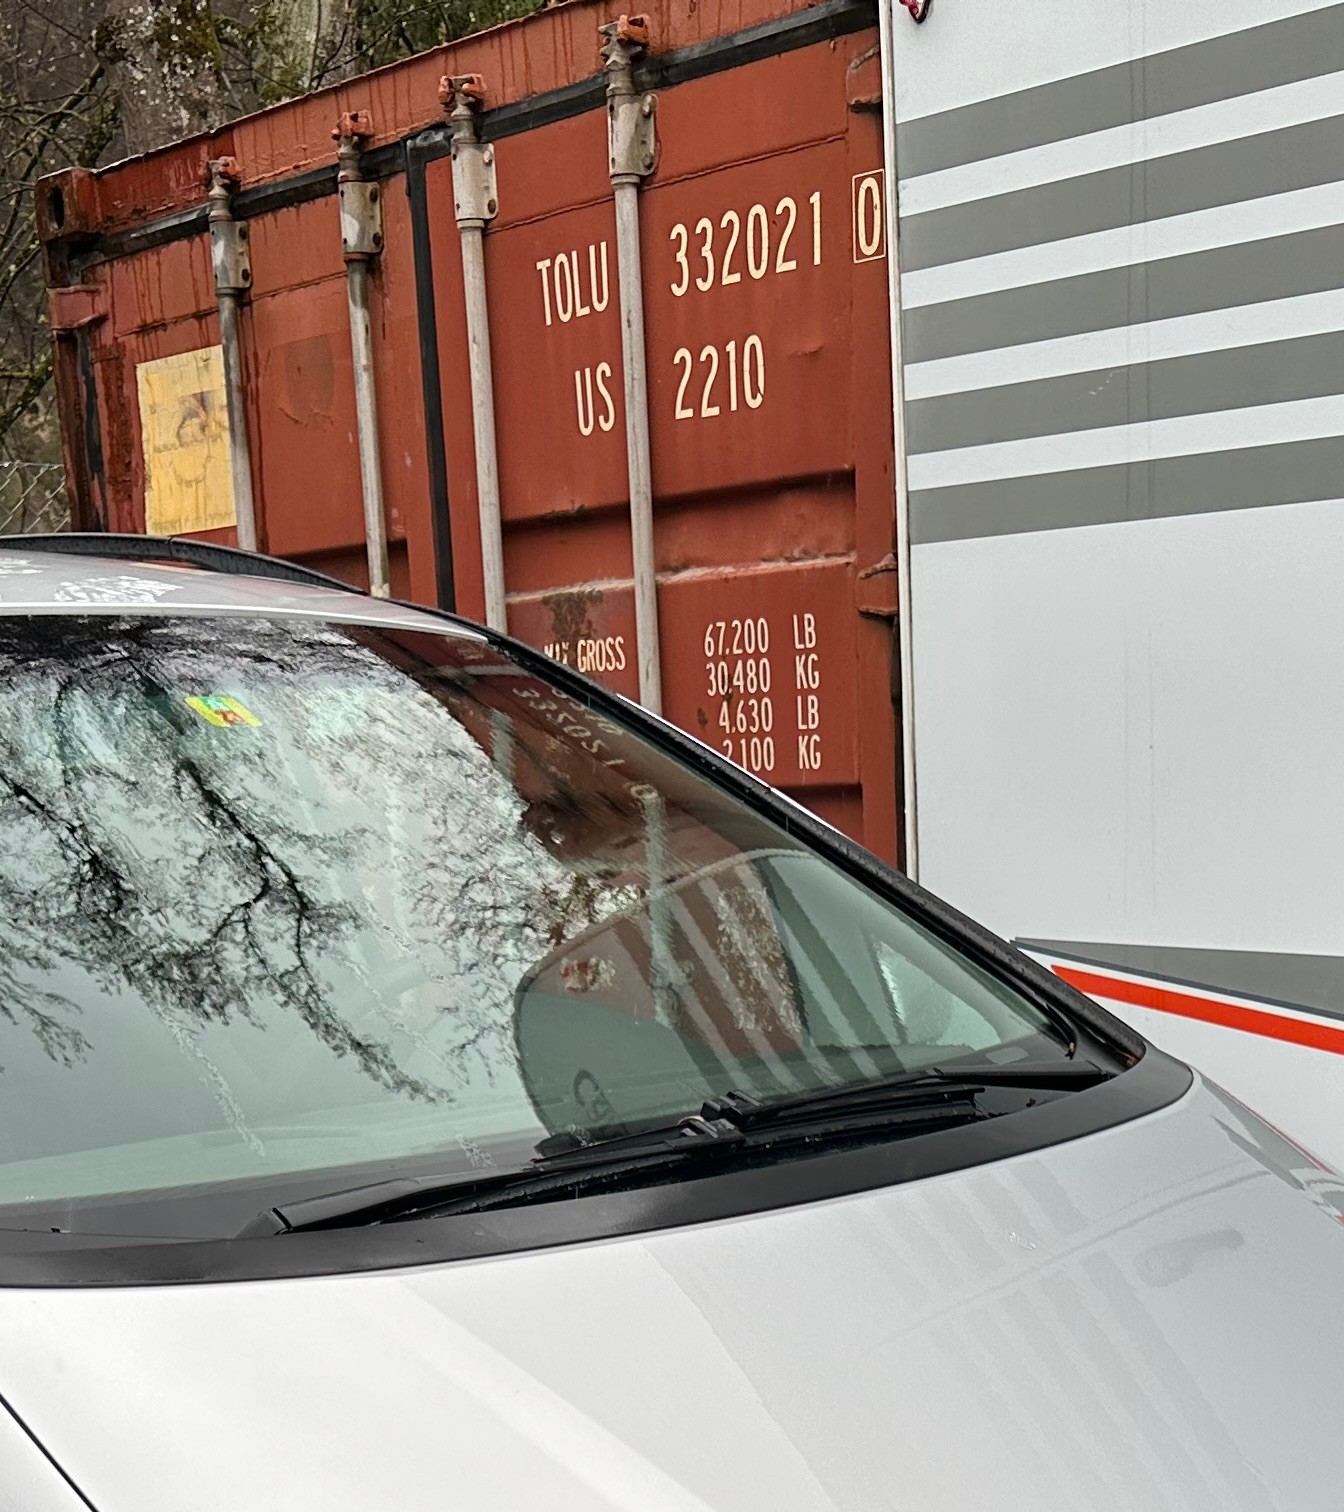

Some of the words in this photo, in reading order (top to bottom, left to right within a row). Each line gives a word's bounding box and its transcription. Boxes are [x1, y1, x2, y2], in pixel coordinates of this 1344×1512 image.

[536, 241, 609, 326] TOLU
[669, 191, 821, 297] 332021
[857, 176, 882, 256] 0
[575, 361, 616, 437] US
[673, 334, 766, 420] 2210
[577, 636, 626, 673] GROSS
[704, 617, 769, 657] 67.200
[792, 613, 817, 650] LB
[706, 657, 771, 696] 30.480
[795, 653, 820, 690] KG
[718, 697, 773, 734] 4.630
[797, 694, 819, 730] LB
[722, 736, 775, 772] 2100
[798, 734, 822, 770] KG
